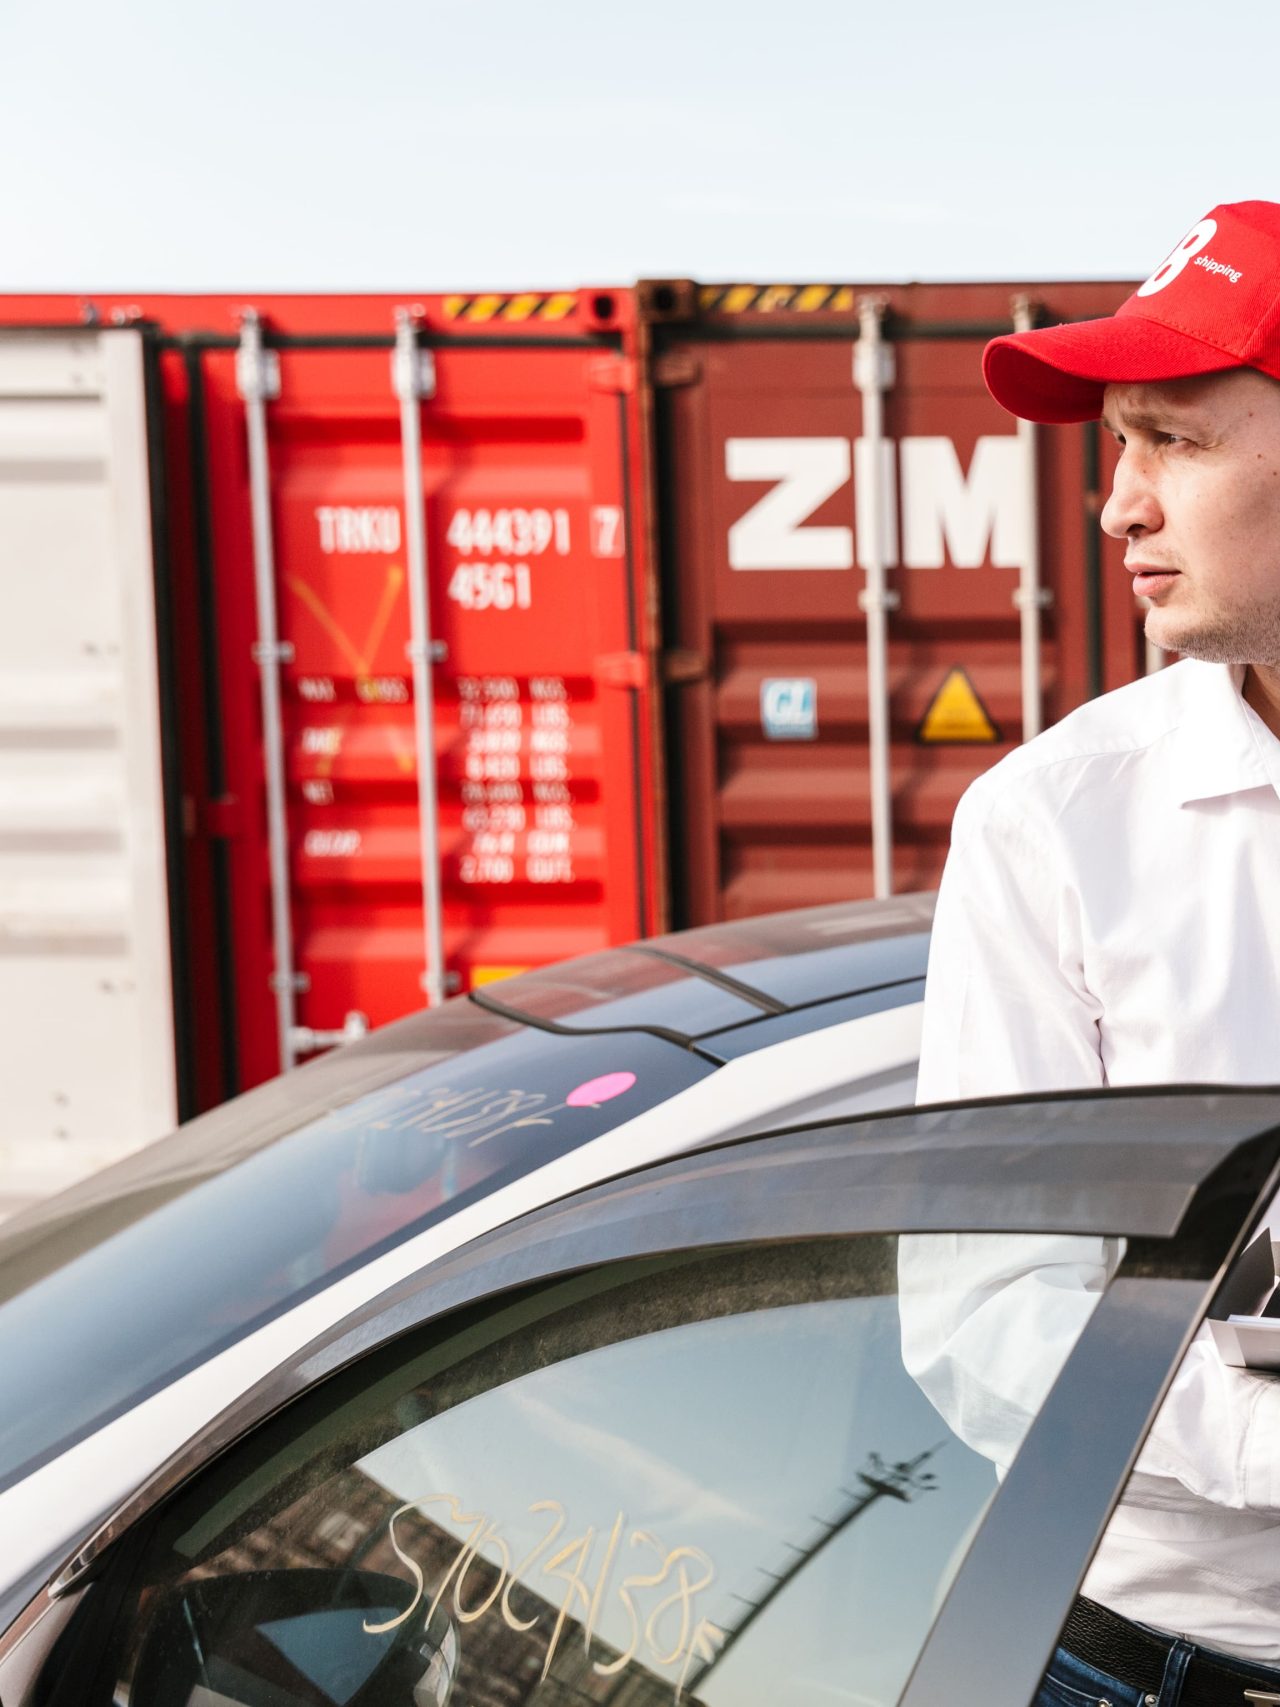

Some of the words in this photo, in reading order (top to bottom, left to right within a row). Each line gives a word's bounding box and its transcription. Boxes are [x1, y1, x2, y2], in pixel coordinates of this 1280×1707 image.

[1194, 255, 1243, 283] shipping
[725, 436, 1028, 570] ZIM
[315, 506, 401, 554] TRKU
[446, 508, 571, 556] 444391
[591, 507, 622, 556] 7
